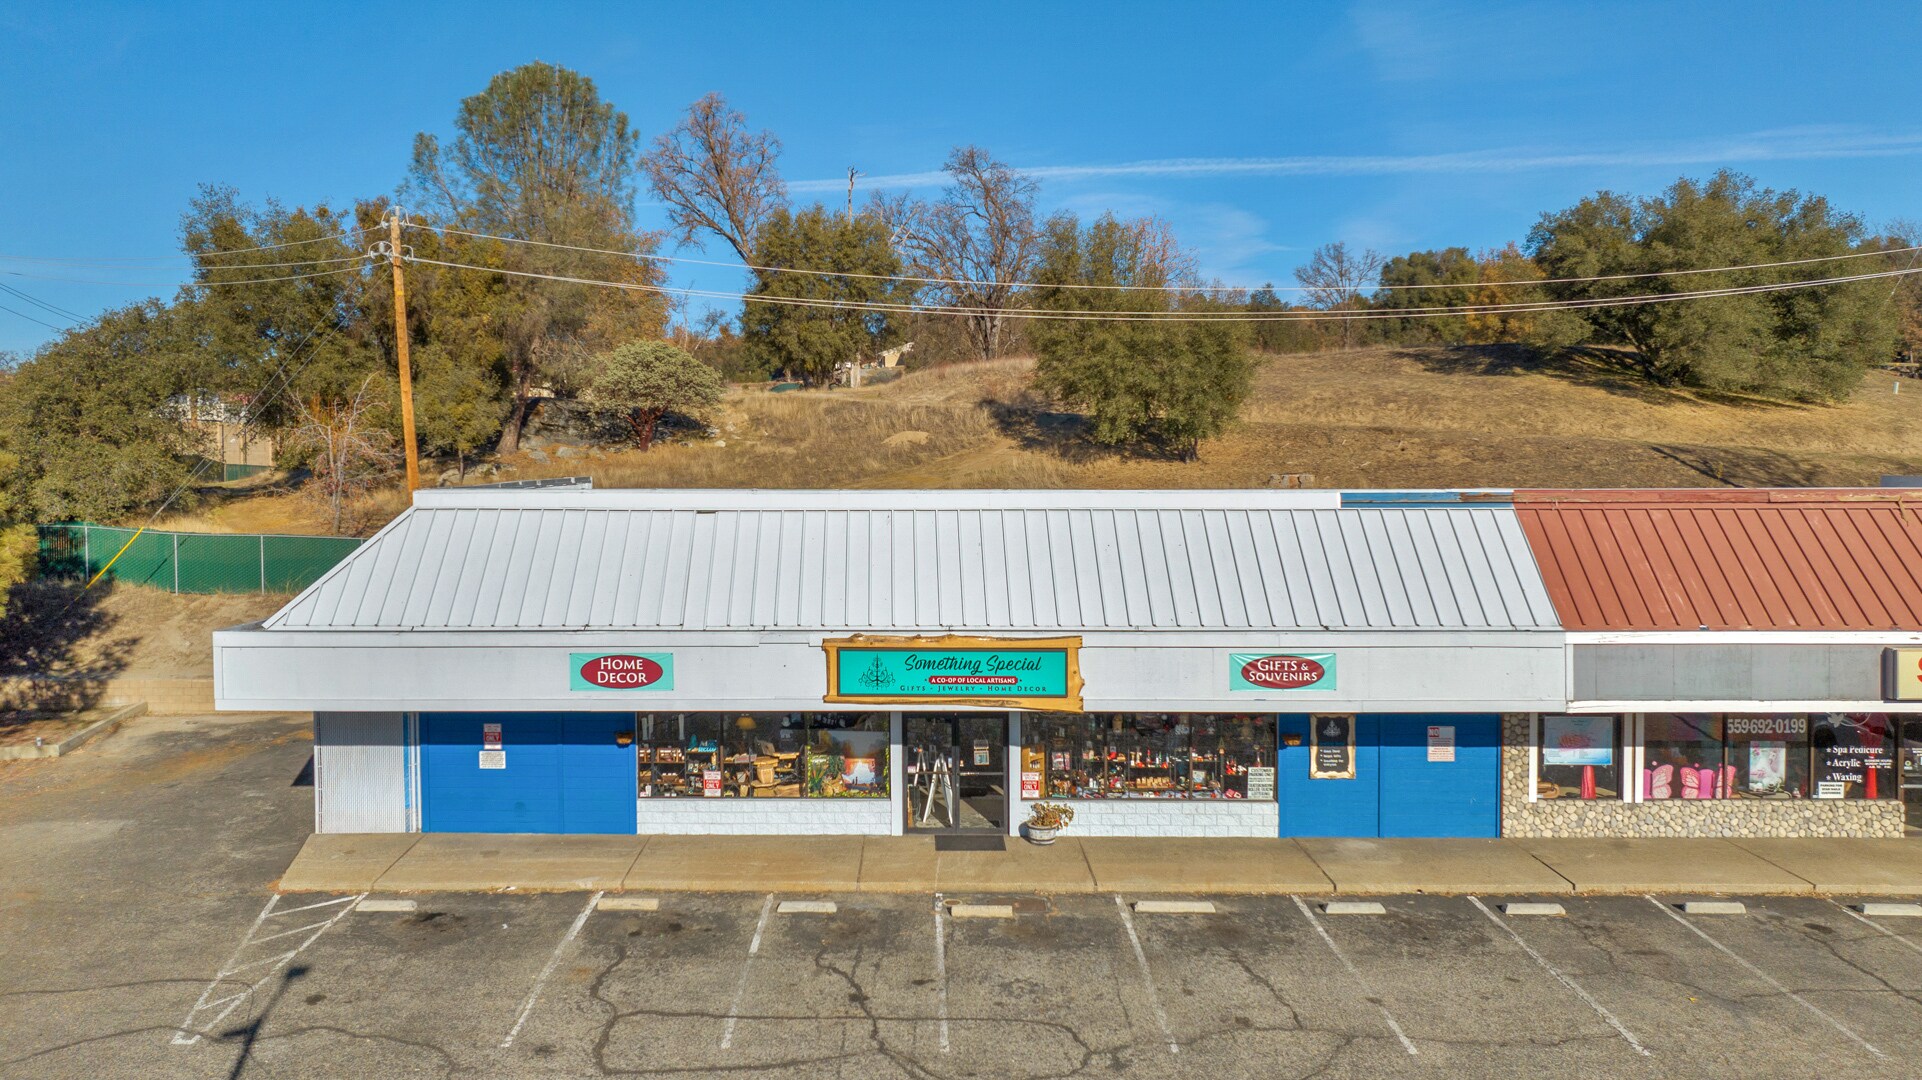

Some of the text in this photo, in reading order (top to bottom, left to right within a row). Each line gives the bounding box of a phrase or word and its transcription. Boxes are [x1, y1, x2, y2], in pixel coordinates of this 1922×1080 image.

[600, 658, 644, 670] HOME
[904, 654, 1042, 675] Something Special
[1257, 659, 1309, 671] GIFTS &
[597, 671, 648, 683] DECOR
[1249, 670, 1318, 682] SOUVENIRS
[1727, 718, 1806, 734] 559-692-0199
[1832, 745, 1884, 756] Spa Pedicure
[1832, 758, 1862, 769] Acrylic
[1832, 772, 1863, 784] Waxing
